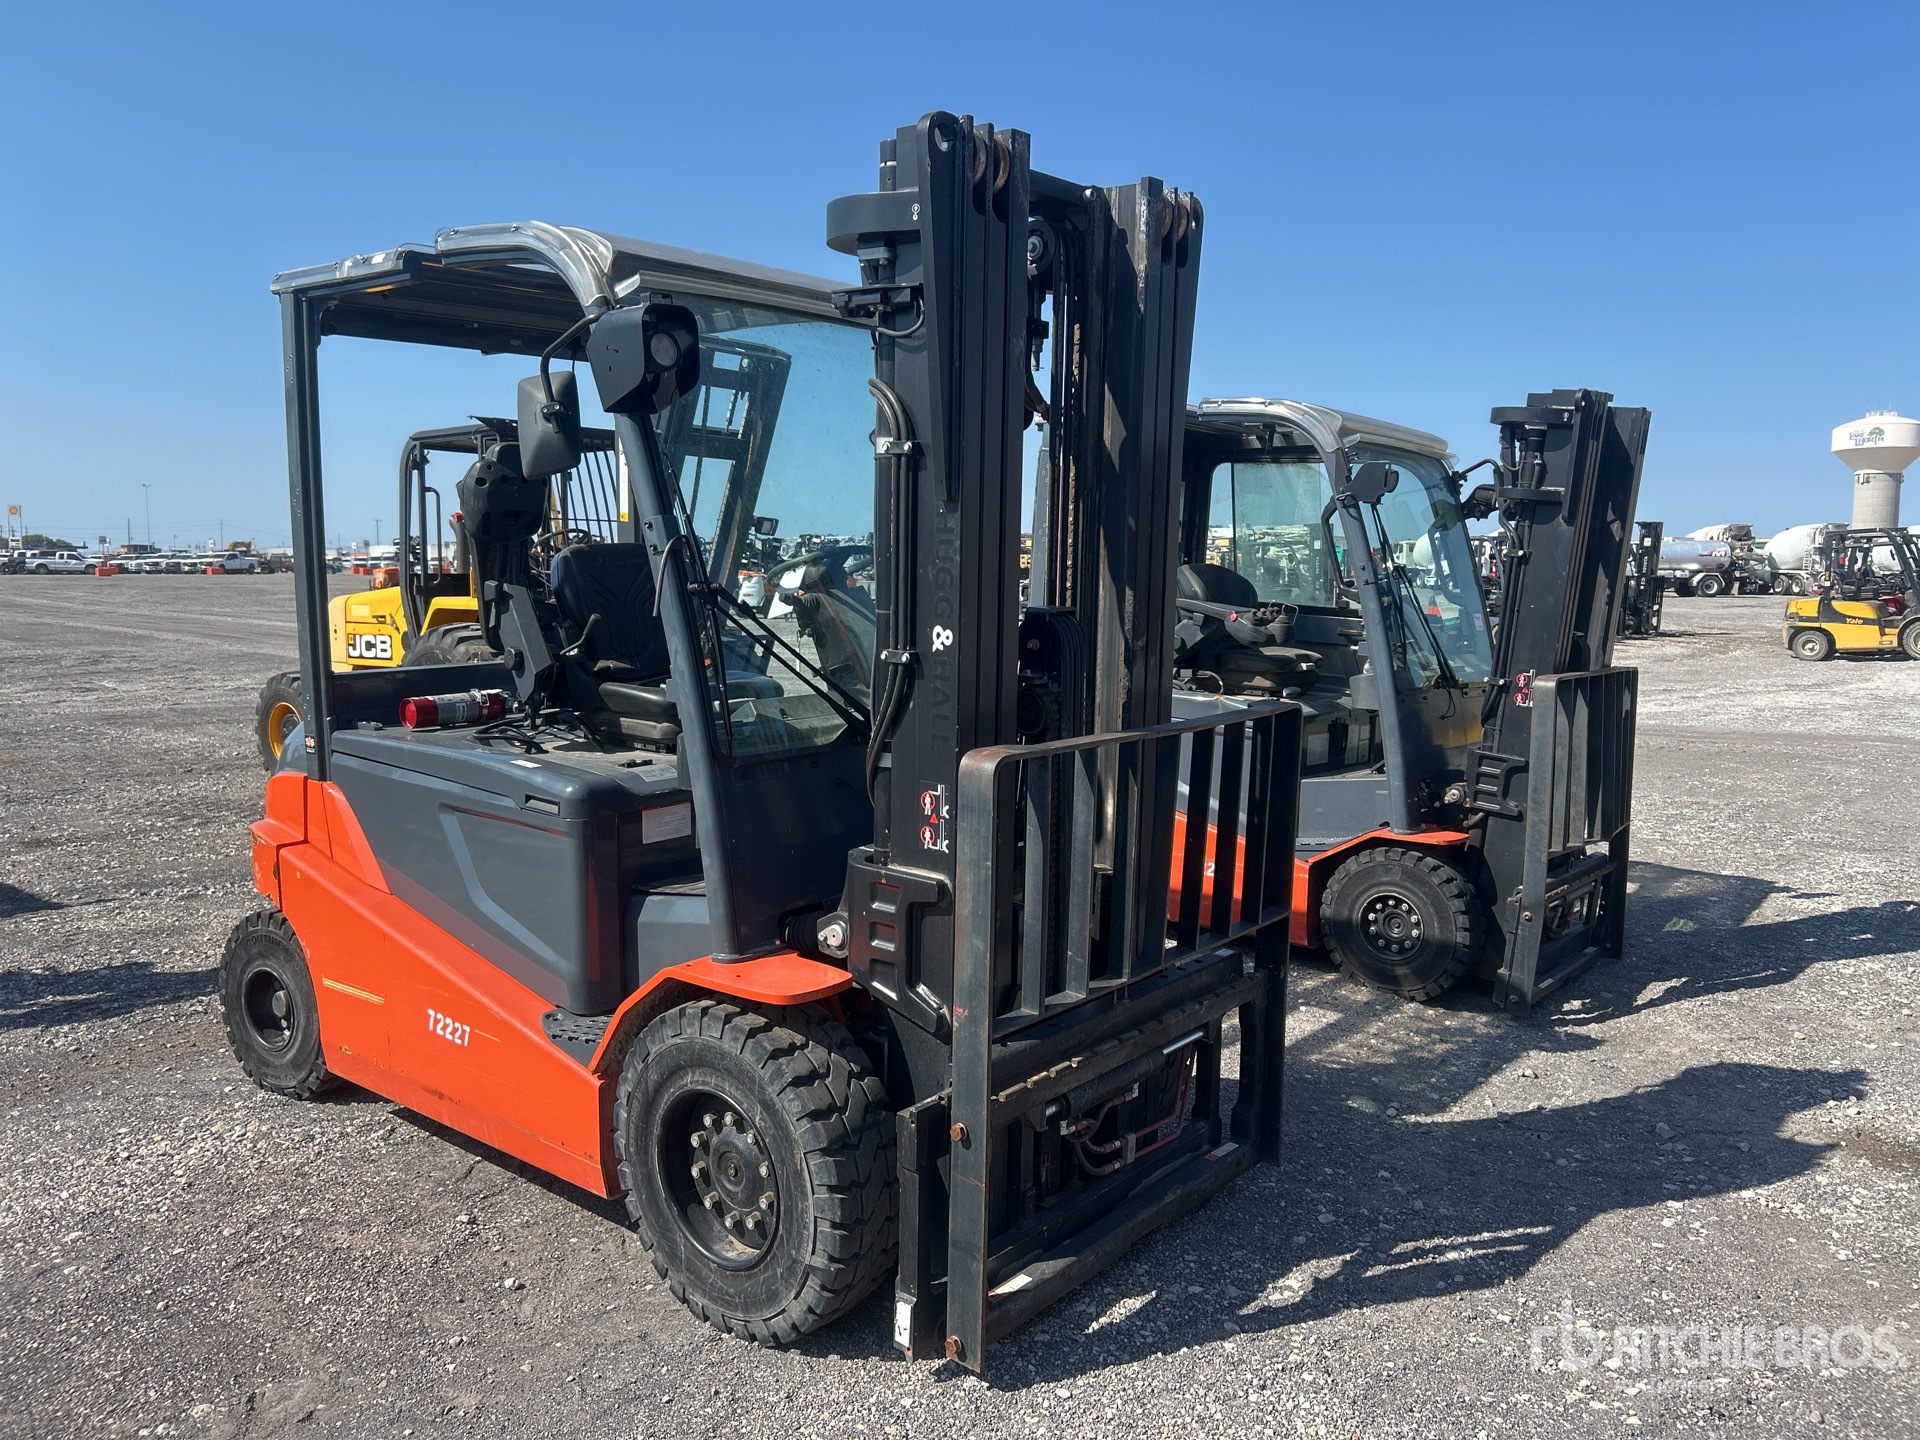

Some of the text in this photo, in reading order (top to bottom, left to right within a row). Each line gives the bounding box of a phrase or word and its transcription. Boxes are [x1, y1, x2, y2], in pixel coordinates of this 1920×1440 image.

[348, 634, 392, 659] JCB
[932, 624, 953, 653] &
[427, 1008, 471, 1047] 72227
